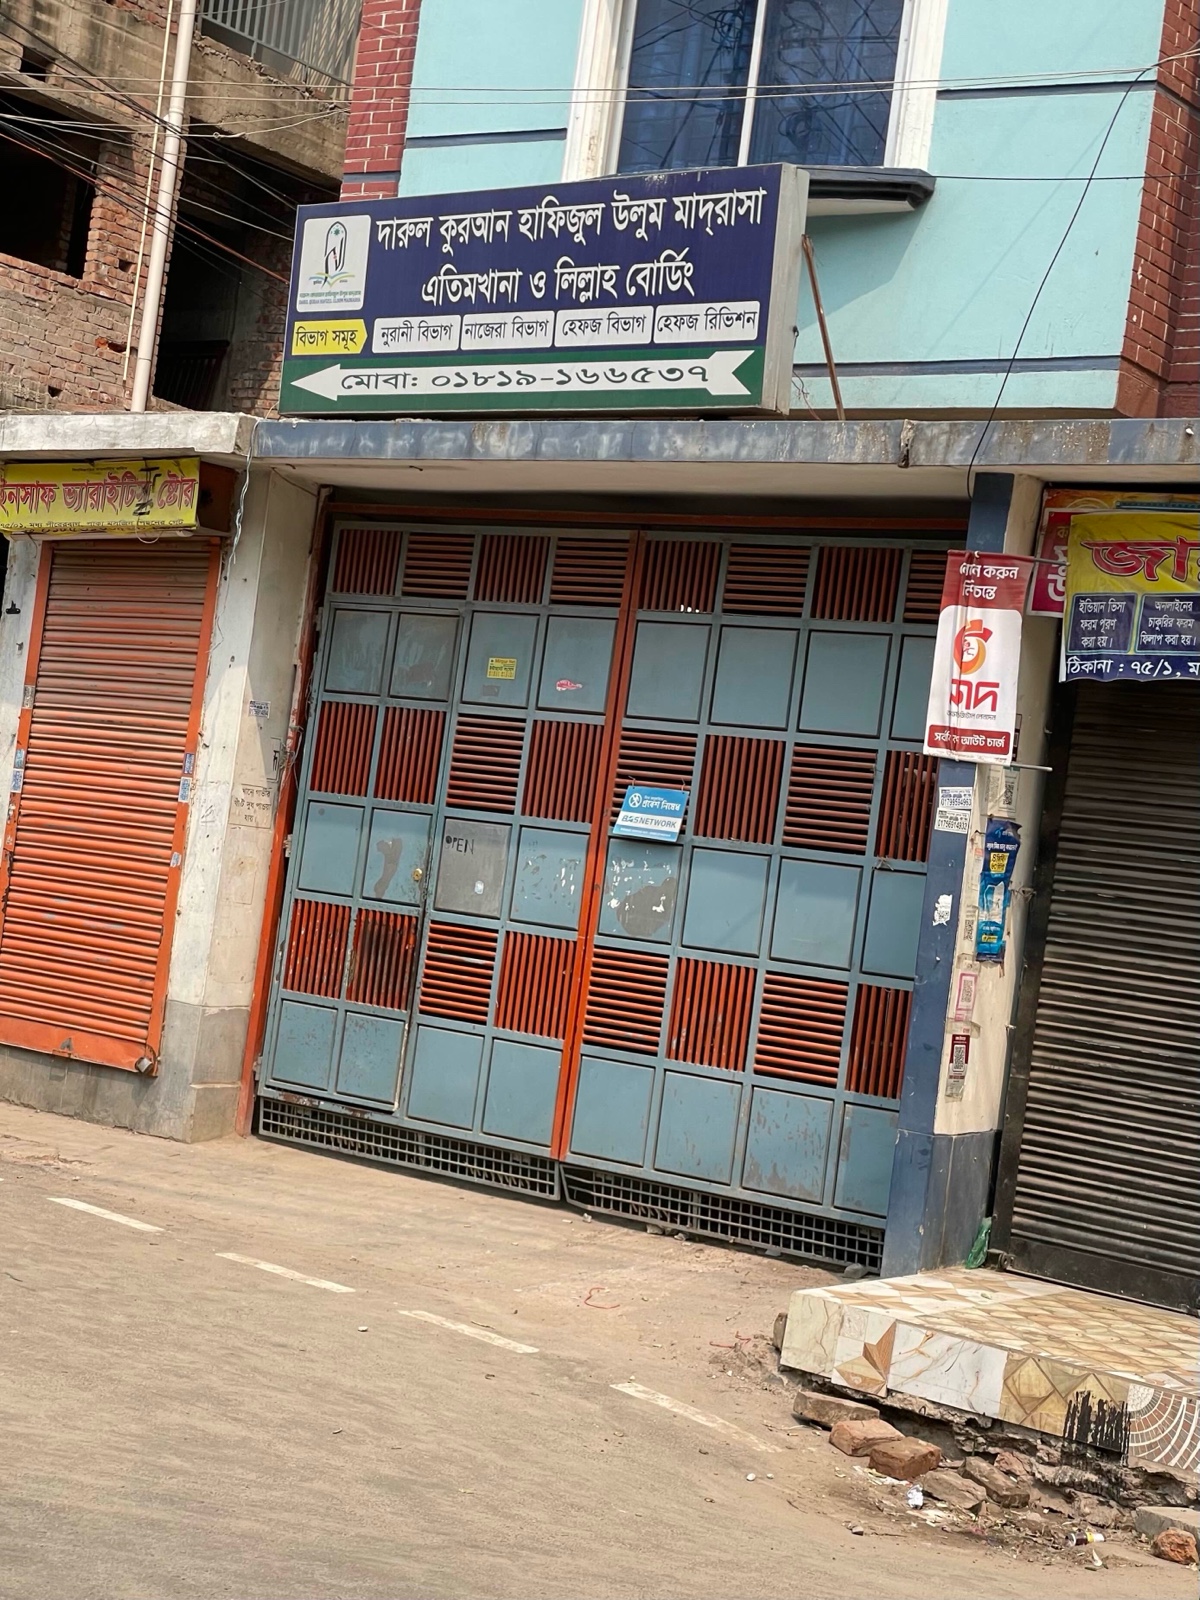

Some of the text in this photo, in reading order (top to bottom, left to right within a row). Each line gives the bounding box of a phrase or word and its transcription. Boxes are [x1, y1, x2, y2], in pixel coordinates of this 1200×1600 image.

[377, 216, 433, 250] দারুল
[439, 210, 511, 254] কুরআন
[518, 196, 606, 245] হাফিজুল
[612, 189, 666, 241] উলুম
[421, 247, 695, 306] এতিমখানা ও লিল্লাহ বোর্ডিং
[464, 316, 549, 340] নাজেরা বিভাগ
[562, 308, 647, 337] হেফজ বিভাগ
[656, 303, 758, 333] হেফজ রিভিশন
[295, 326, 359, 351] বিভাগ সমূহ
[417, 320, 453, 342] বিভাগ
[432, 364, 709, 389] ০১৮১৯-১৬৬৫৩৭
[157, 470, 198, 511] ষ্টোর
[1080, 535, 1200, 583] জা
[983, 565, 1020, 580] করুন
[1108, 597, 1127, 614] ভিসা
[1080, 618, 1098, 632] ফরম
[1176, 617, 1196, 630] ফরম
[1164, 633, 1180, 646] করা
[1066, 655, 1114, 675] ঠিকানা
[1187, 661, 1200, 676] ম
[960, 734, 986, 747] আউট
[986, 735, 1006, 748] চার্জ
[660, 799, 682, 812] নিষেধ
[639, 817, 677, 828] NETWORK
[445, 835, 475, 855] OPEN
